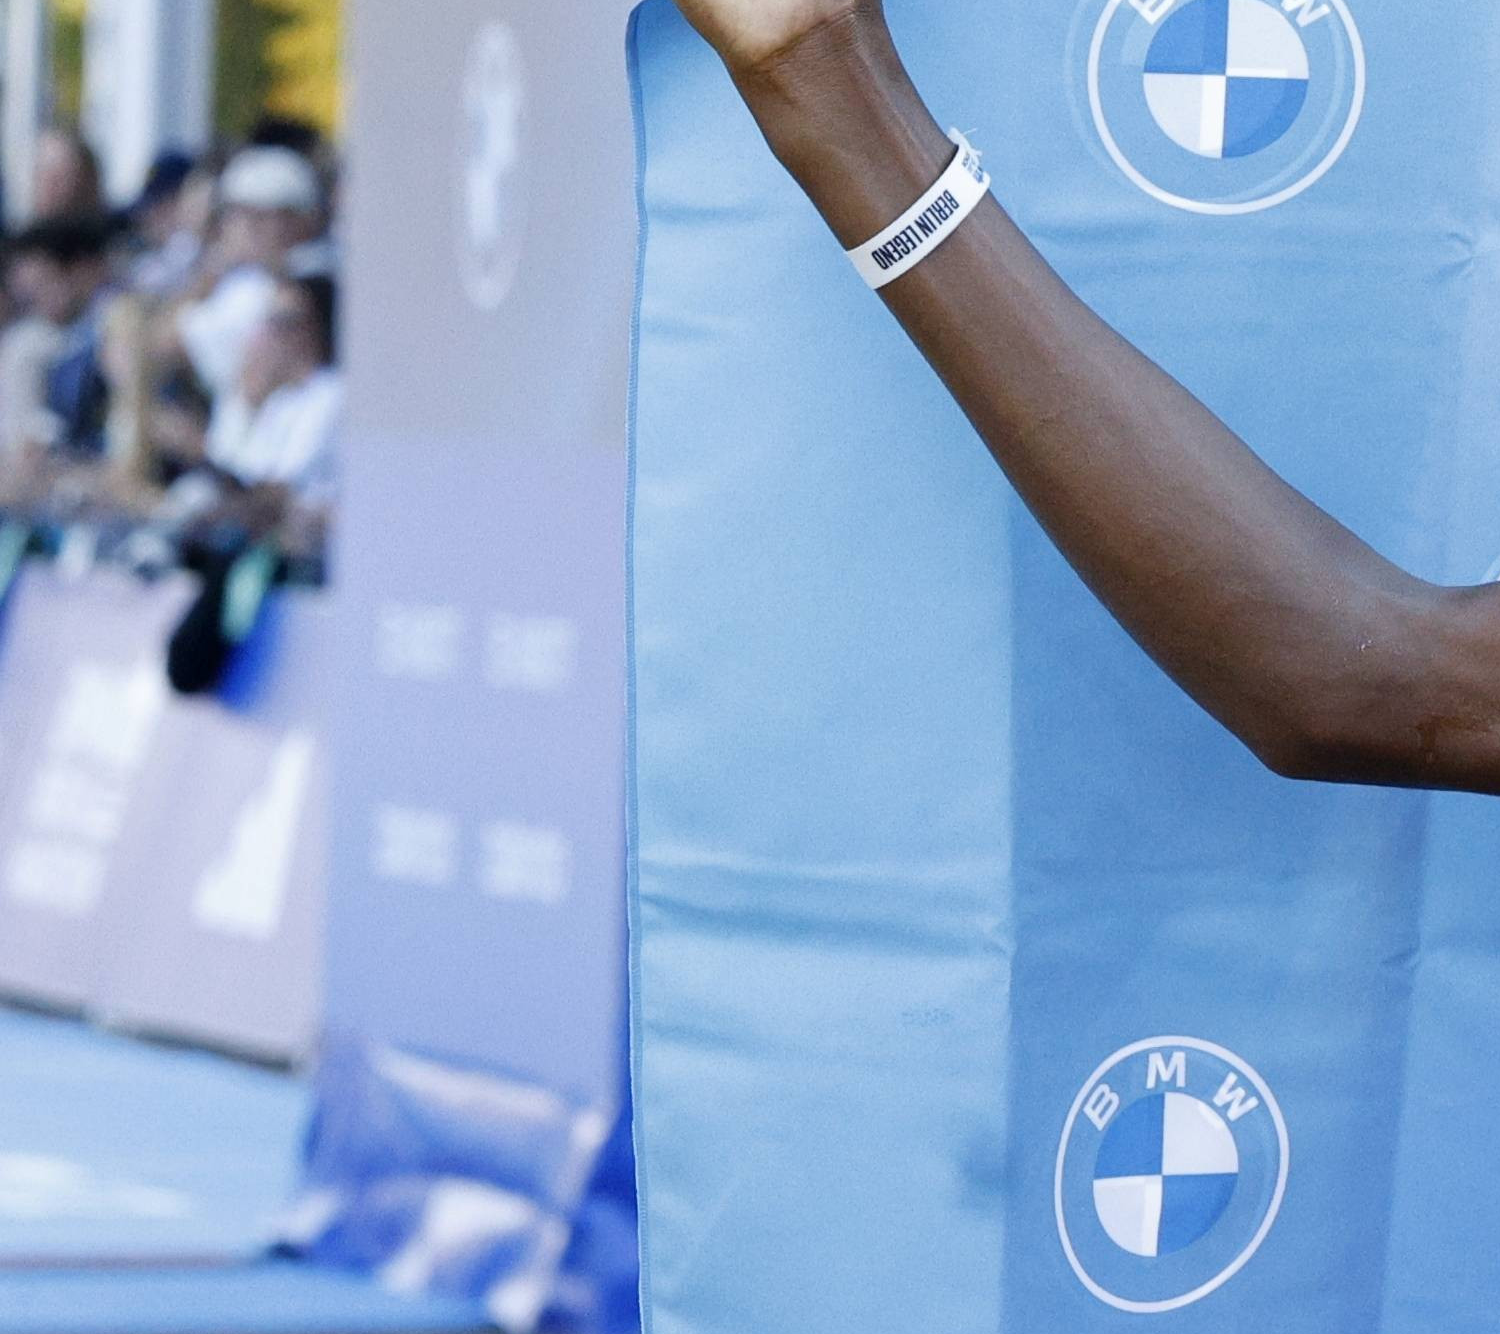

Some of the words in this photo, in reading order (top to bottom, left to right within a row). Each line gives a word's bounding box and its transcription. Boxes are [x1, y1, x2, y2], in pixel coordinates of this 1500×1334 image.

[914, 189, 960, 238] BERLIN
[871, 224, 924, 270] LEGEND
[1083, 1051, 1259, 1132] BMW
